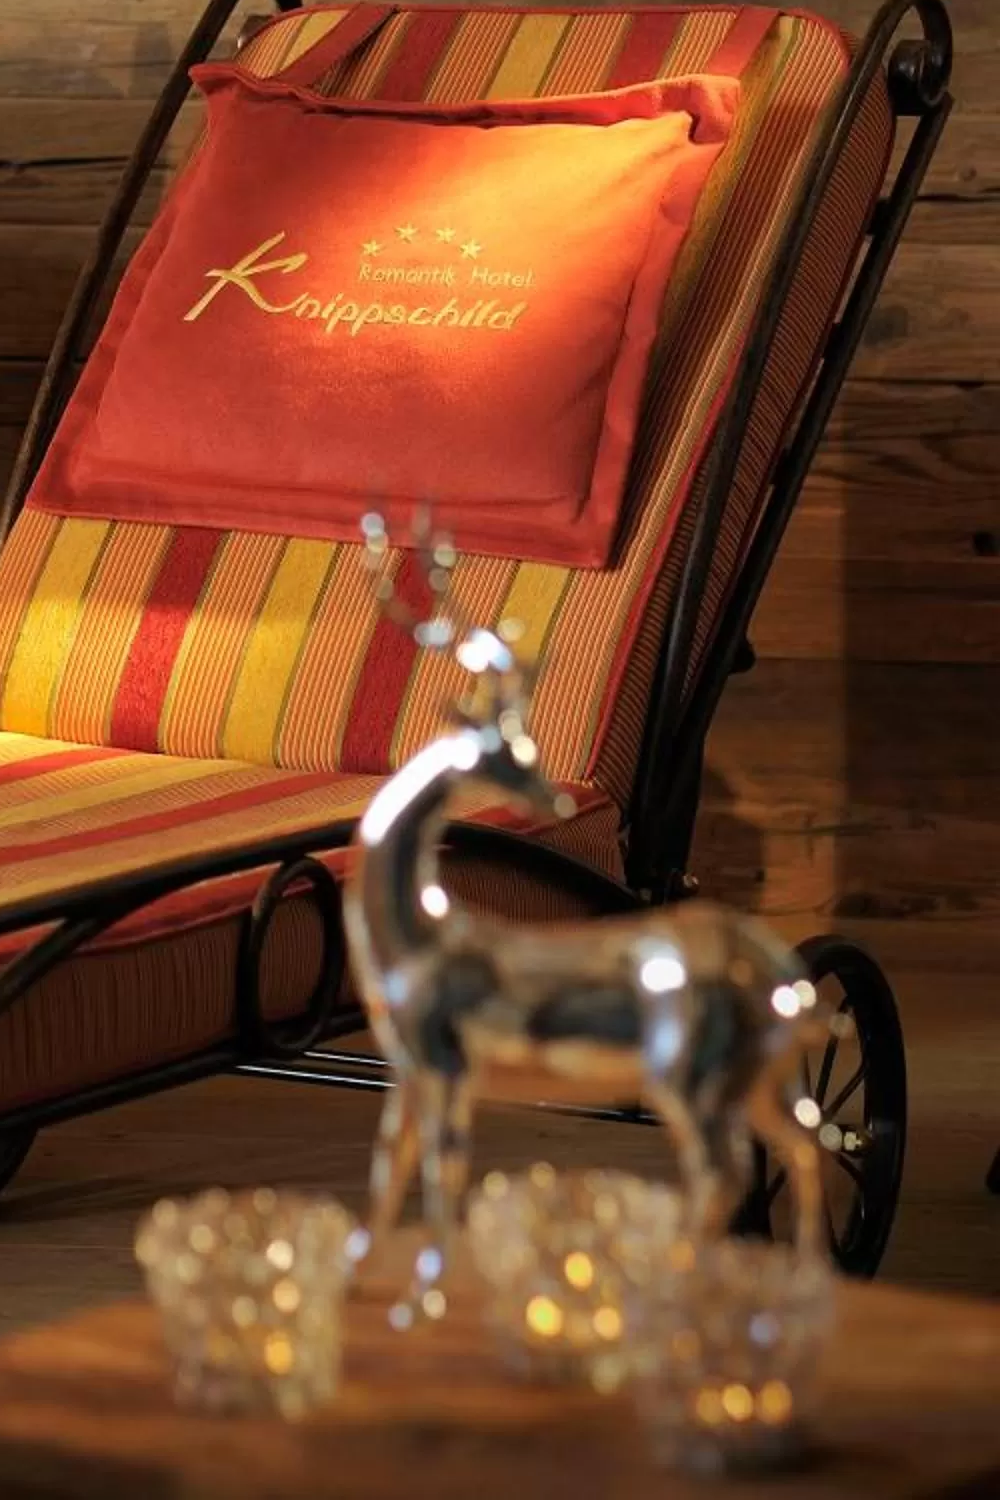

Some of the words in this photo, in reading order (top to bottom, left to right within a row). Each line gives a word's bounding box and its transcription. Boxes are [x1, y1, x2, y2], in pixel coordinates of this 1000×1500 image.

[183, 230, 527, 336] Knippschild
[358, 263, 455, 286] Romantik
[470, 266, 534, 288] Hotel
